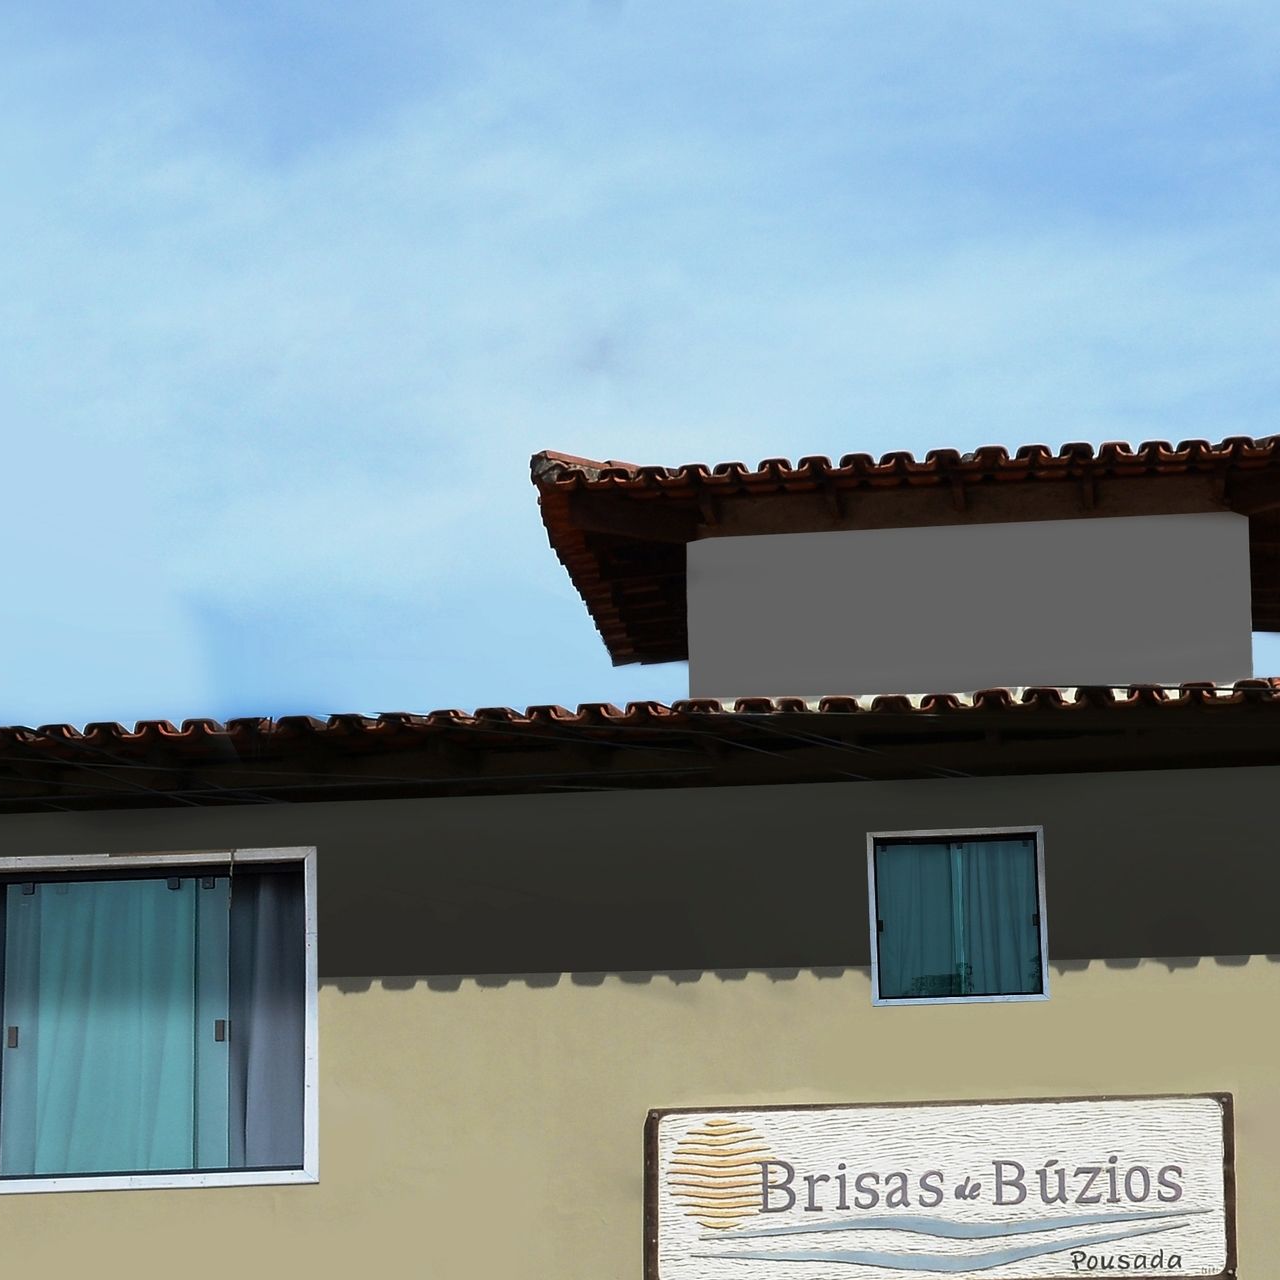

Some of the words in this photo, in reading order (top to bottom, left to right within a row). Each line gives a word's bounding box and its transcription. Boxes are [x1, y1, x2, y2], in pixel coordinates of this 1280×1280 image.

[758, 1160, 944, 1213] Brisas
[954, 1176, 982, 1200] de
[992, 1156, 1183, 1206] Búzios
[1070, 1249, 1182, 1270] Pousada
